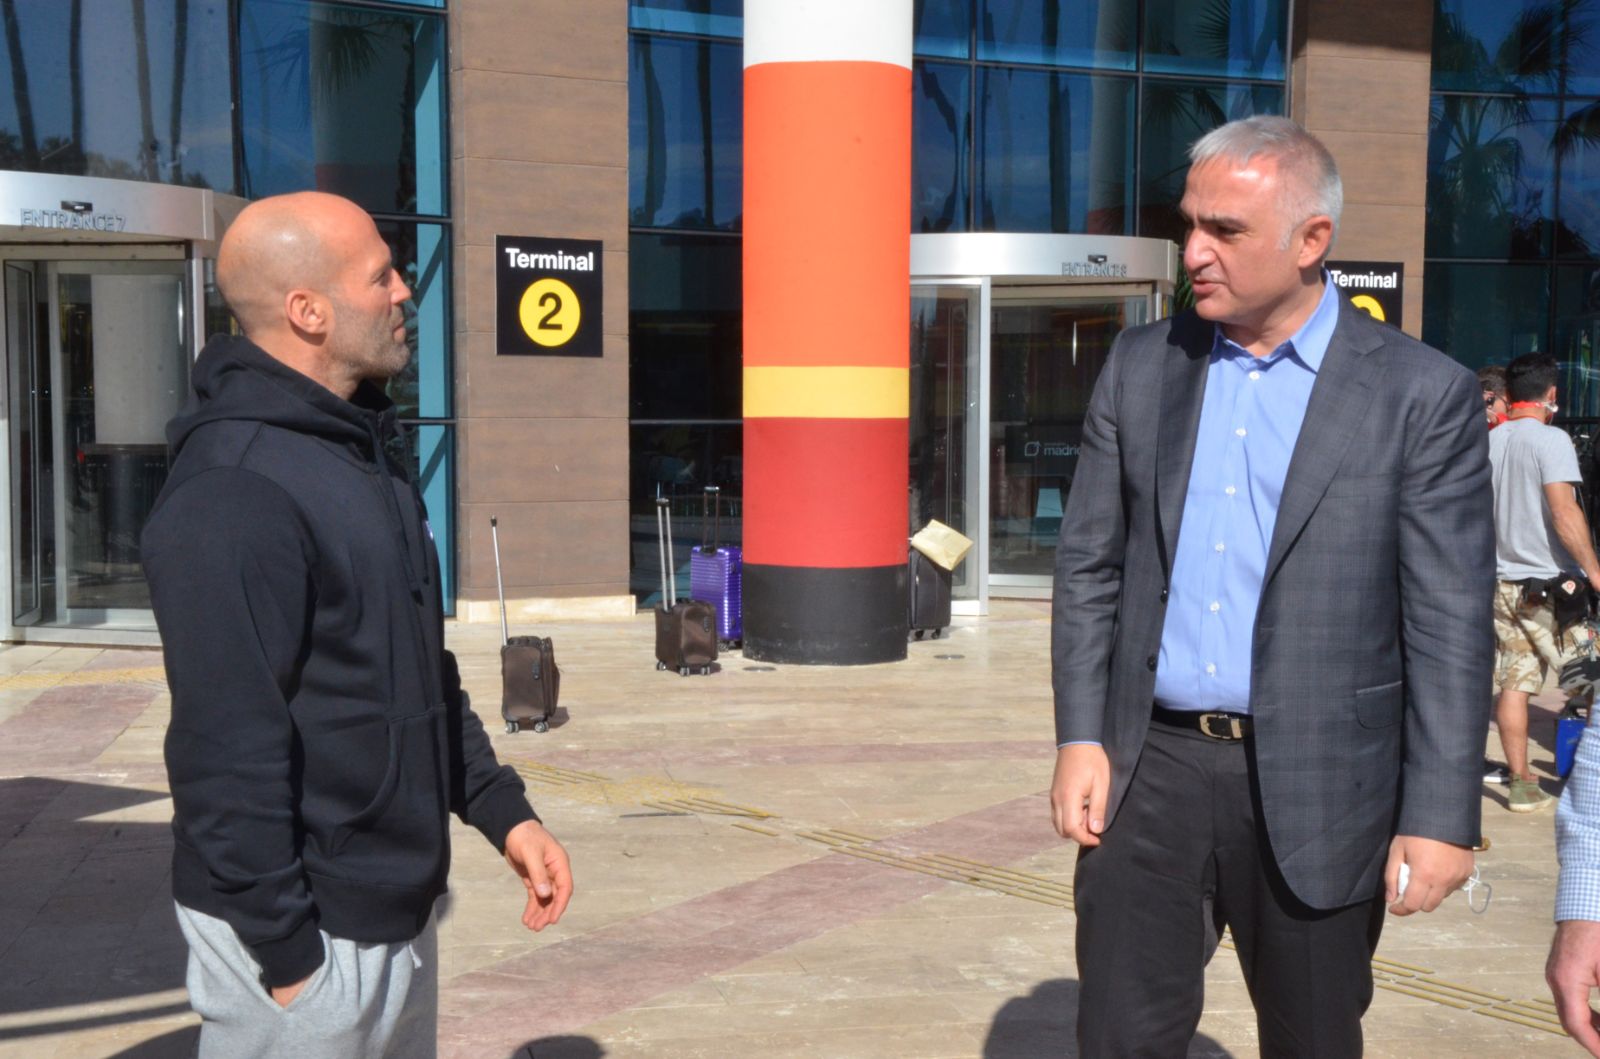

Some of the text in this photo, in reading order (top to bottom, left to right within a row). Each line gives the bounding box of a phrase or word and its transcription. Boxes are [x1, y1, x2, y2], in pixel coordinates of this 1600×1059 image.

[505, 247, 594, 271] Terminal
[1330, 270, 1397, 288] Terminal
[538, 292, 563, 331] 2
